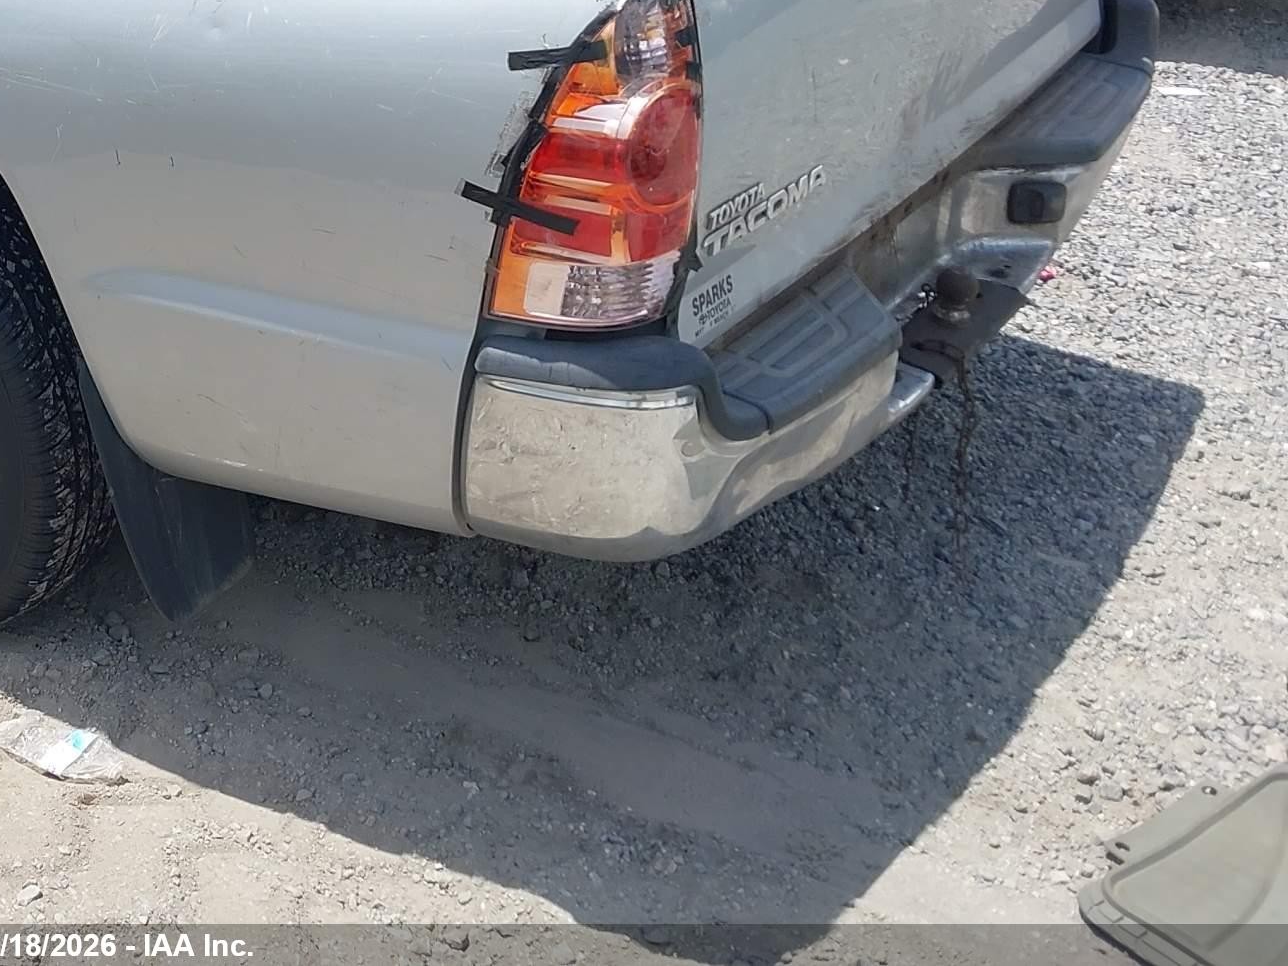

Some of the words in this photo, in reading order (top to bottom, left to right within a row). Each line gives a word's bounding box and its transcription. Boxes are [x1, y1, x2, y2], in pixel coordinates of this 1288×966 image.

[703, 165, 827, 256] TACOMA
[706, 183, 765, 229] TOYOTA
[692, 274, 733, 317] SPARKS
